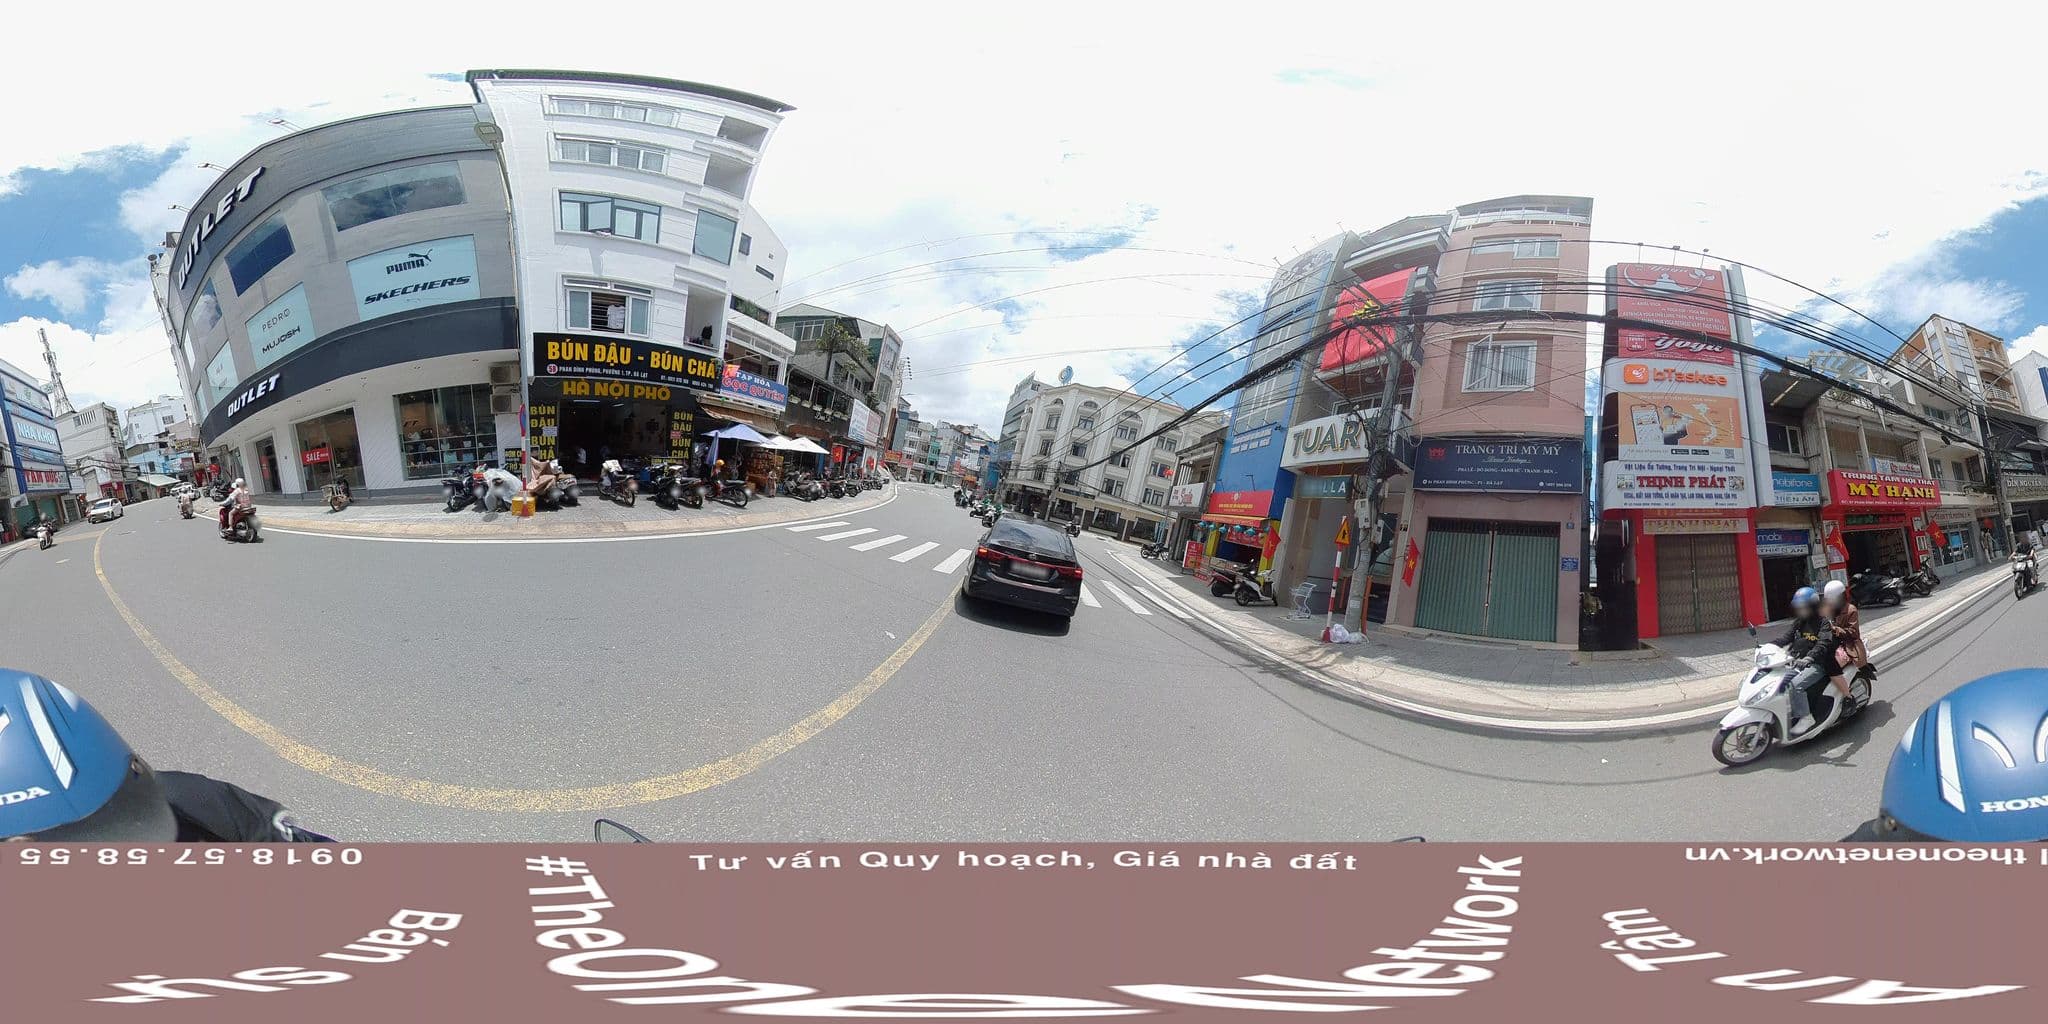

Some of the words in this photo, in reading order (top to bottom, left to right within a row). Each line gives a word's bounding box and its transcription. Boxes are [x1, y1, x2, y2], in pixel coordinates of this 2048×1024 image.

[179, 166, 266, 290] OUTLET
[386, 258, 425, 275] PUMA
[364, 275, 471, 305] SKECHERS
[262, 308, 291, 332] PEDRO
[262, 326, 302, 354] MUJOSH
[547, 338, 589, 361] BÚN
[594, 342, 631, 367] ĐẬU
[650, 350, 683, 373] BÚN
[687, 357, 716, 379] CHẢ
[721, 376, 748, 392] GỌC
[1653, 368, 1728, 386] bTaskee
[227, 372, 281, 417] OUTLET
[563, 377, 590, 396] HÀ
[594, 378, 630, 400] NỘI
[633, 380, 671, 400] PHỐ
[1292, 419, 1378, 458] TUAR
[305, 451, 321, 462] SALE
[540, 446, 555, 460] HẢ
[1455, 444, 1495, 455] TRANG
[1499, 442, 1518, 455] TRÍ
[1521, 442, 1540, 456] MỸ
[1542, 443, 1562, 456] MỸ
[1673, 463, 1688, 472] Trang
[1841, 471, 1877, 480] TRUNG
[1636, 475, 1686, 490] THỊNH
[1688, 474, 1727, 488] PHÁT
[1847, 480, 1882, 497] MỸ
[1885, 485, 1936, 501] HẠNH
[0, 786, 51, 806] DA
